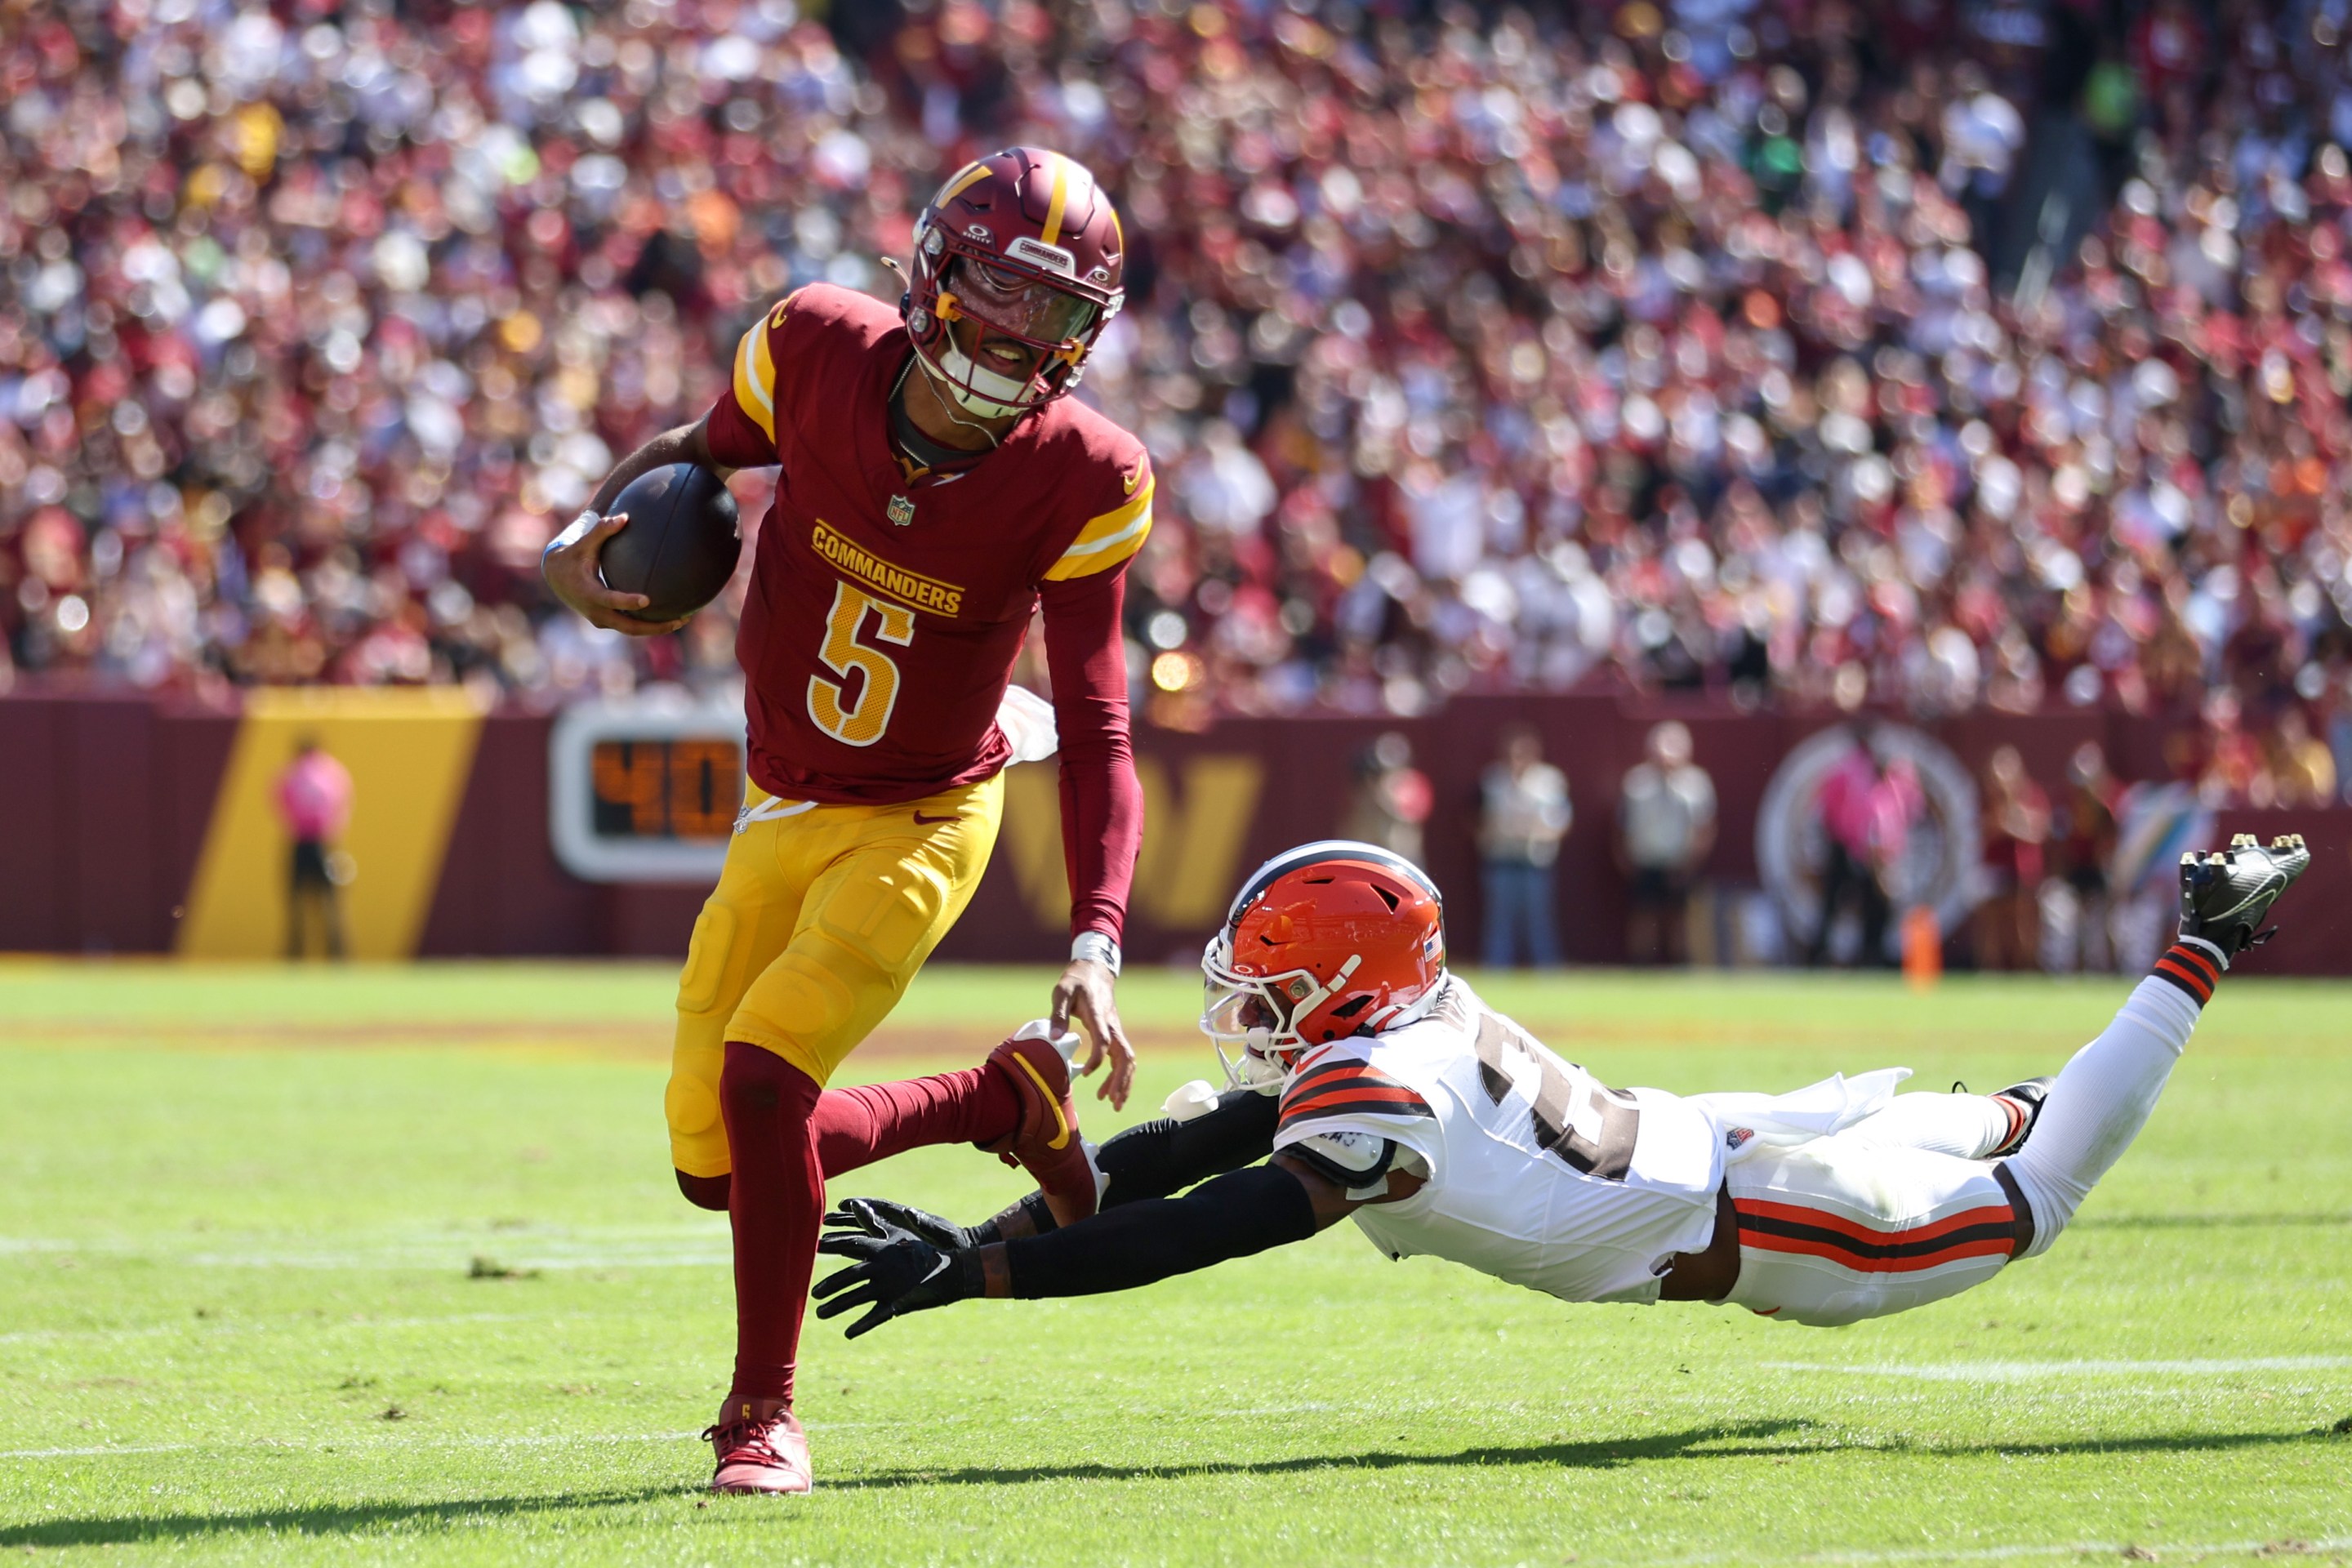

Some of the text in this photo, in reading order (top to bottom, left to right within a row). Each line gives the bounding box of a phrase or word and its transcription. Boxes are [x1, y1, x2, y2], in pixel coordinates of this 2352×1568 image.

[1020, 242, 1069, 266] COMMANDERS
[890, 506, 909, 523] NFL
[811, 525, 964, 615] COMMANDERS
[807, 578, 916, 747] 5
[591, 739, 743, 841] 40
[1474, 1013, 1640, 1183] 2
